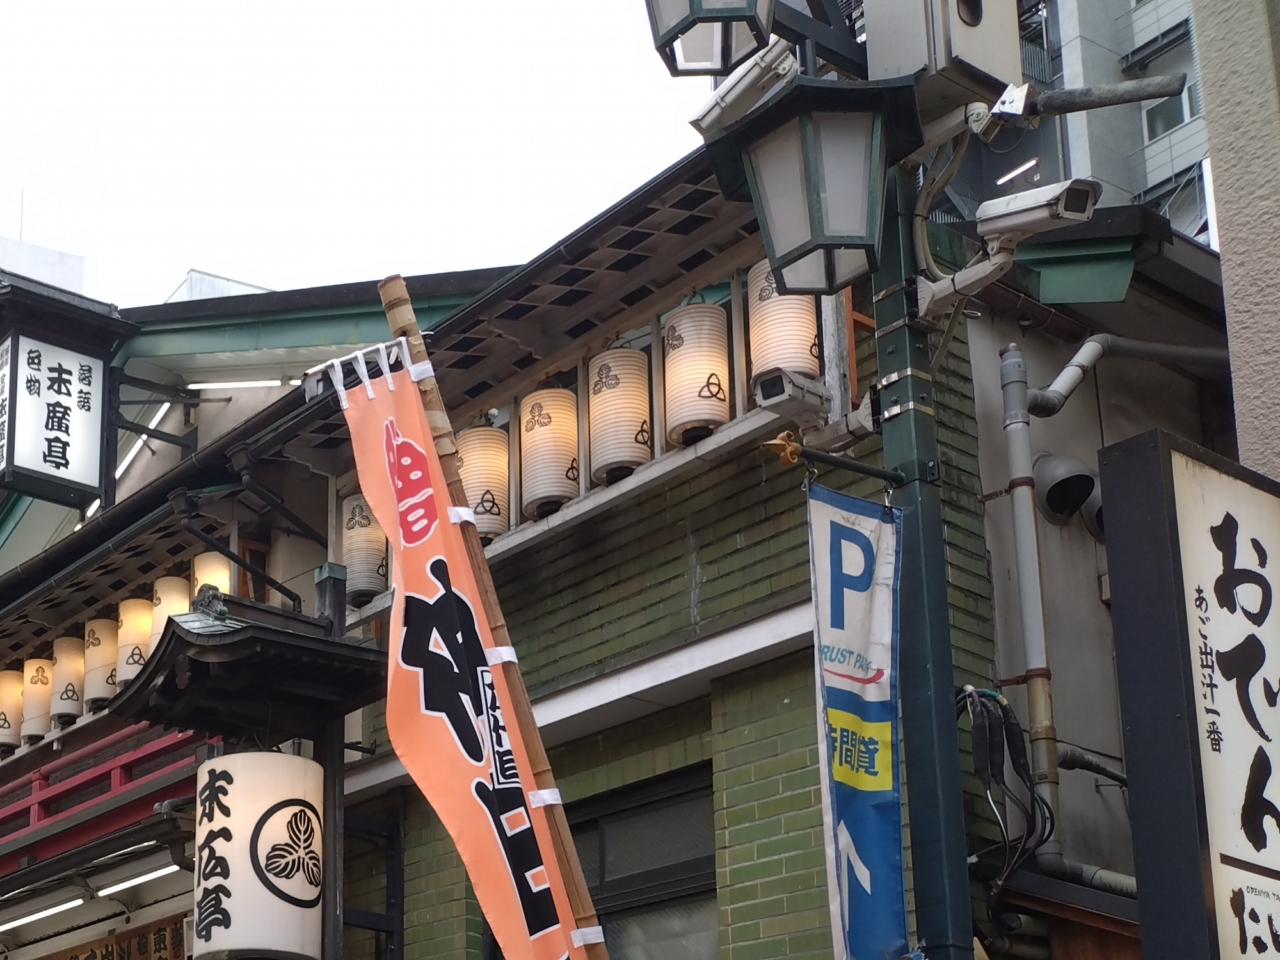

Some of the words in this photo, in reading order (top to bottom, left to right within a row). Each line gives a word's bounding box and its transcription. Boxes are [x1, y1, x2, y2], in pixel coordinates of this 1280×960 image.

[25, 348, 42, 398] 色物
[42, 362, 73, 471] 末廣亭
[829, 519, 875, 631] P
[195, 768, 234, 942] 末広亭
